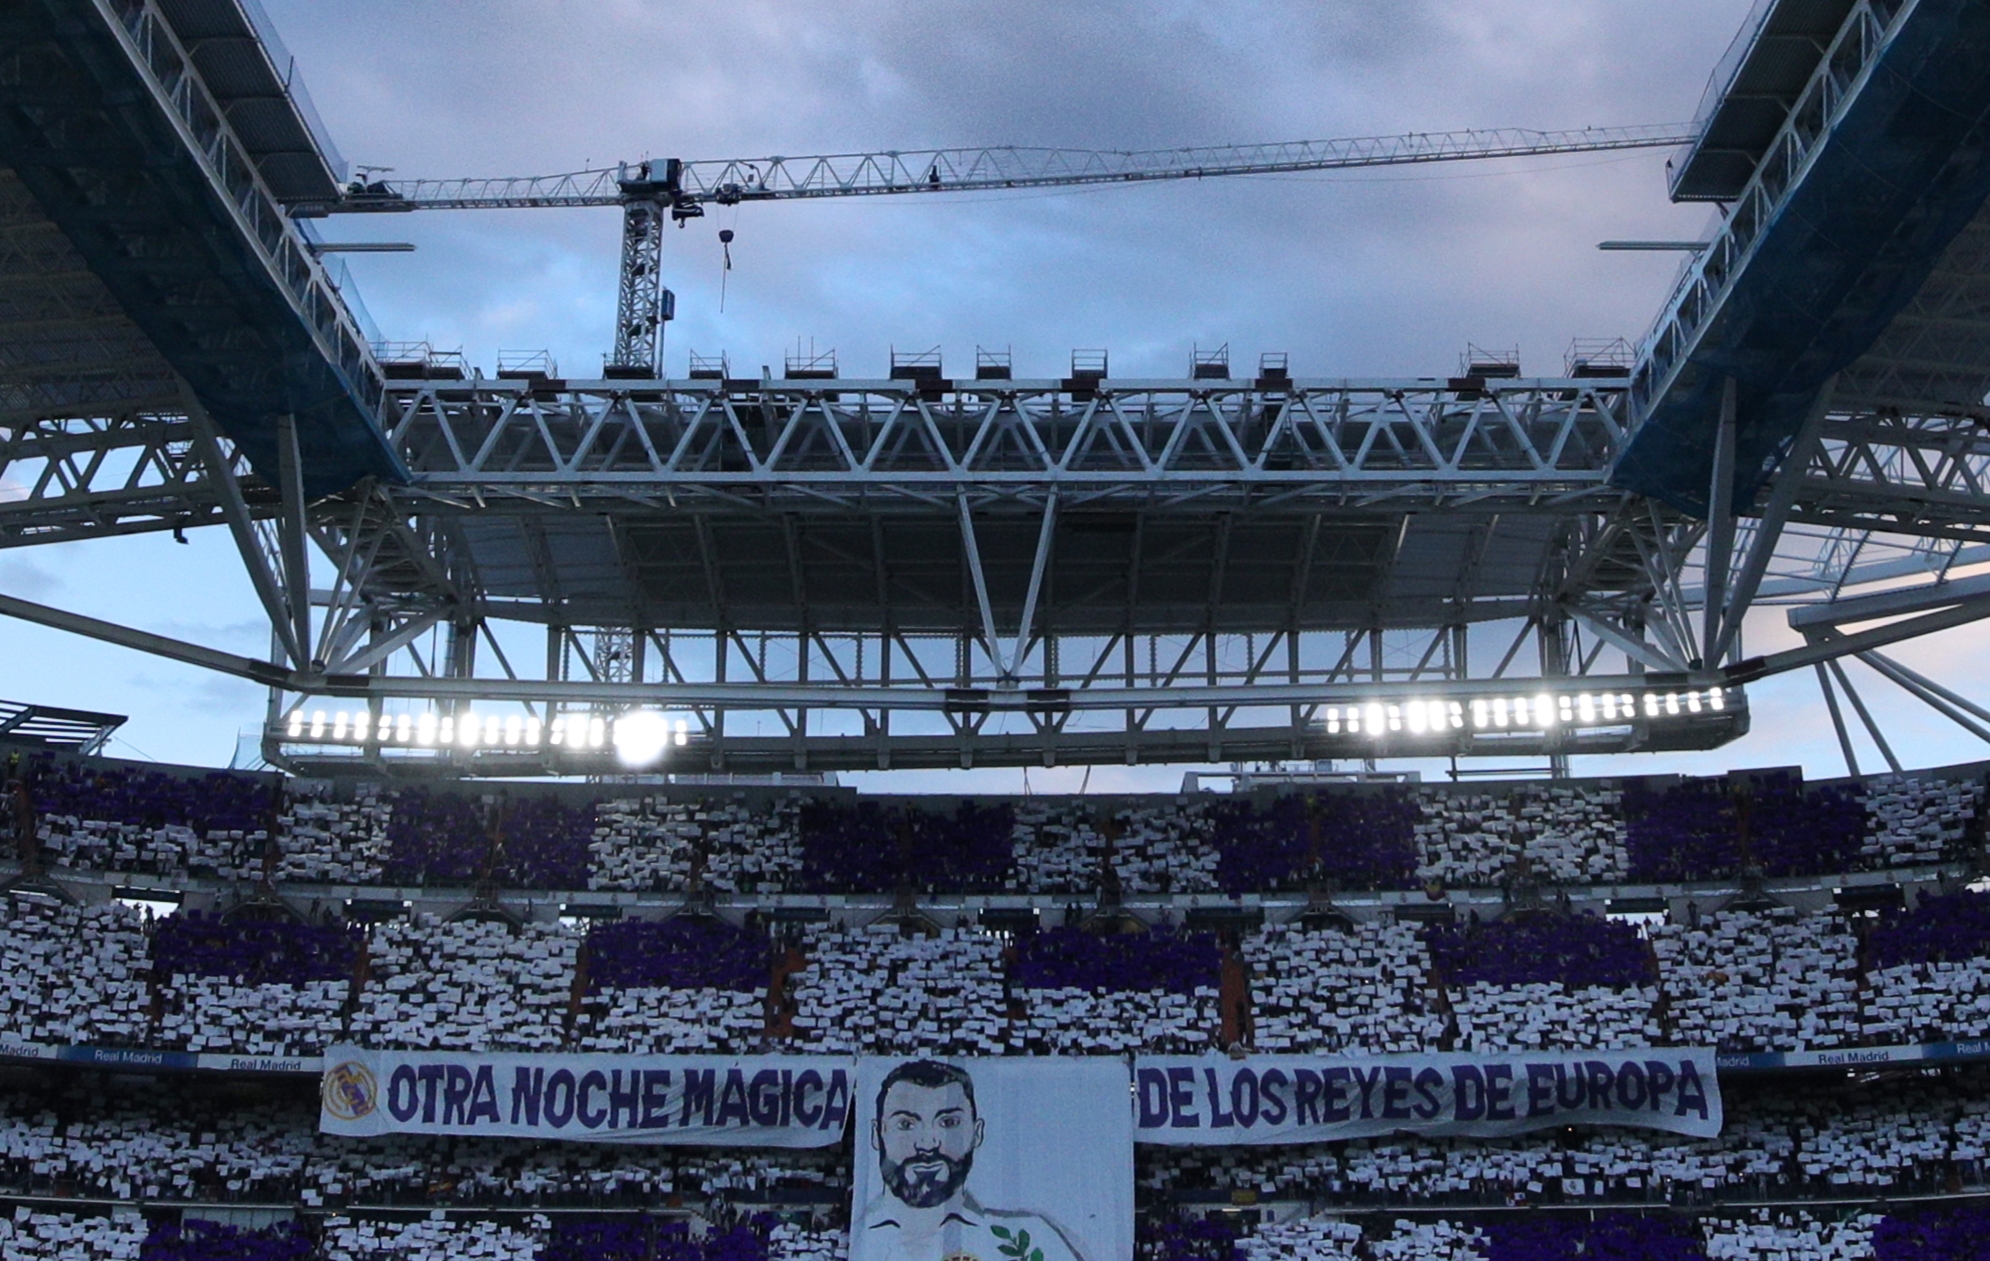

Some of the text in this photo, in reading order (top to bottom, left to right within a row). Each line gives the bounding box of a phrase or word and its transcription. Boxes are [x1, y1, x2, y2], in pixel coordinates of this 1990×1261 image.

[1957, 1041, 1982, 1054] Real
[94, 1049, 163, 1064] Real Madrid
[1818, 1051, 1889, 1064] Real Madrid
[231, 1058, 302, 1071] Real Madrid
[387, 1064, 501, 1125] OTRA
[511, 1066, 671, 1129] NOCHE
[1137, 1060, 1709, 1128] DE LOS REYES DE EUROPA
